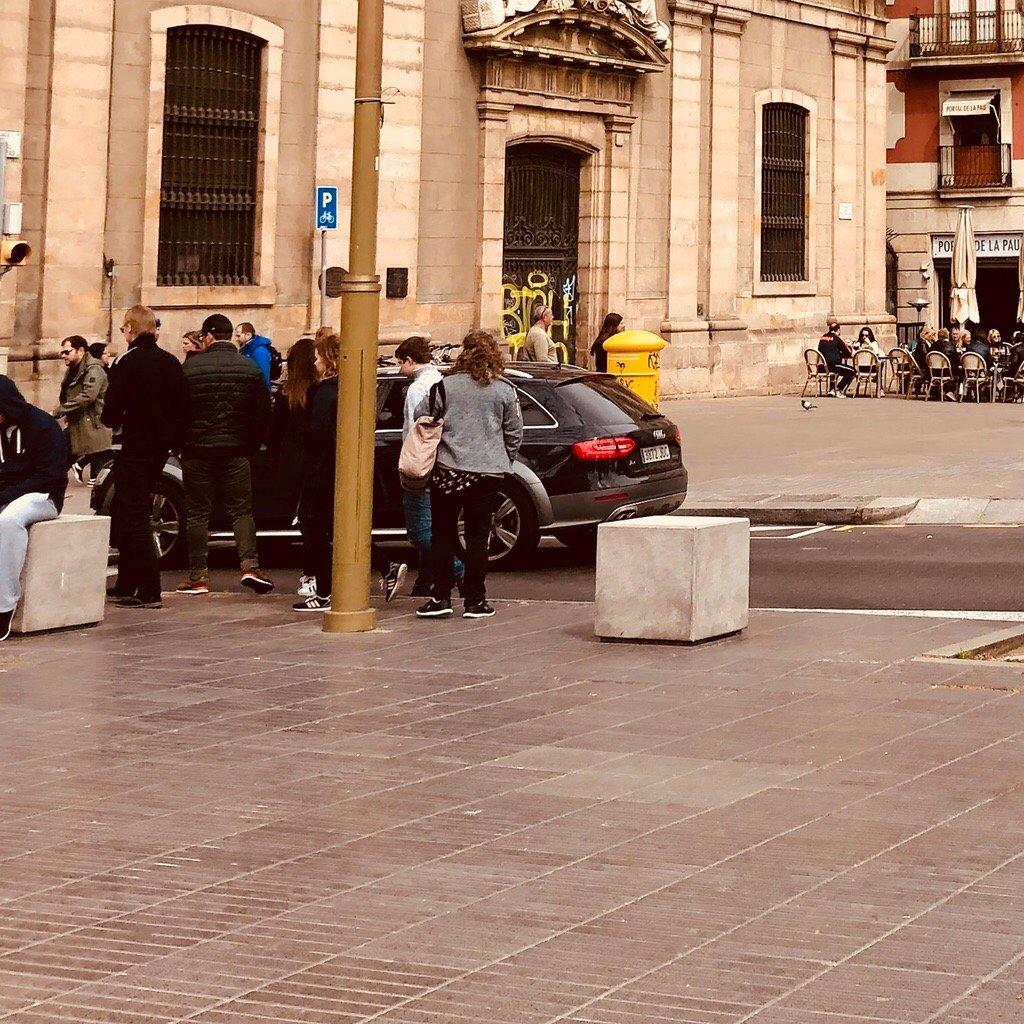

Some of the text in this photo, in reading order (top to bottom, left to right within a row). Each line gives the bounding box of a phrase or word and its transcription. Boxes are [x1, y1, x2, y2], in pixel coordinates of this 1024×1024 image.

[322, 192, 333, 208] P
[938, 240, 955, 253] POR
[988, 239, 1000, 251] LA
[1002, 239, 1020, 251] PAU
